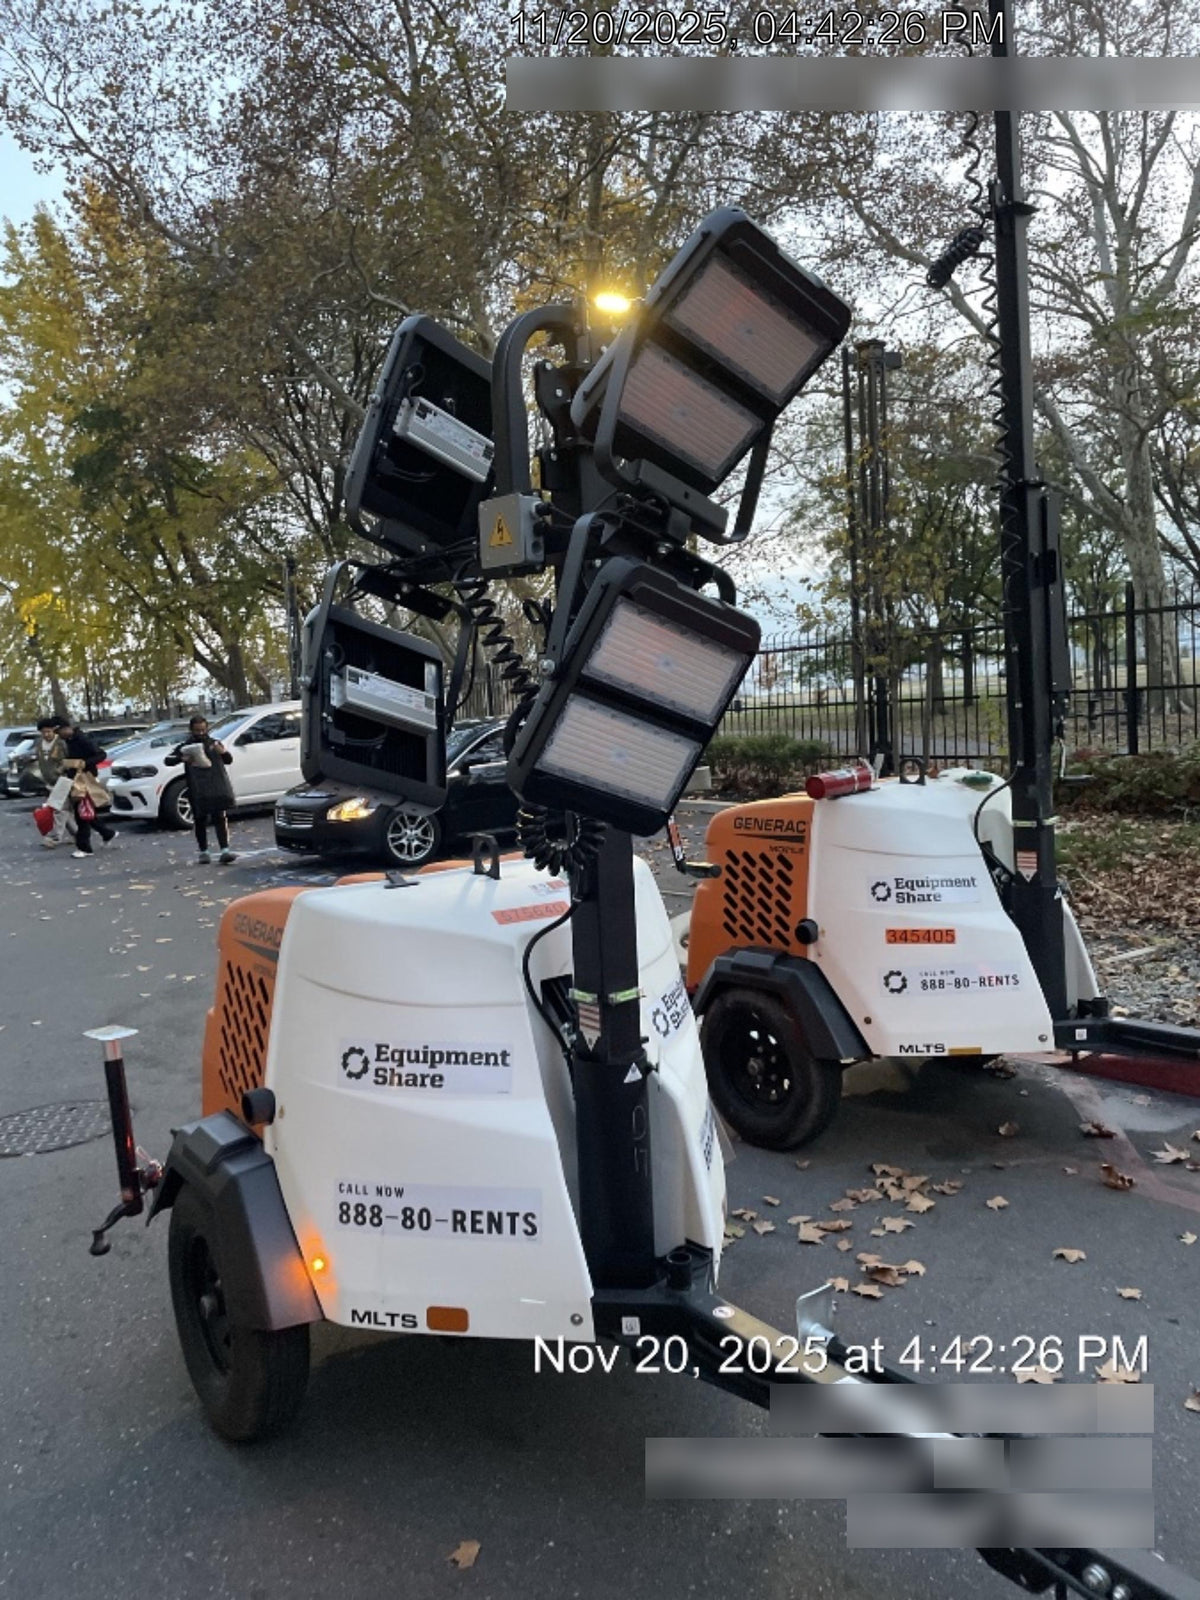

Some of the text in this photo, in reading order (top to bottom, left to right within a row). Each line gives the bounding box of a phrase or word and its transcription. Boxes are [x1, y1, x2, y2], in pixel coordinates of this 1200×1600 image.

[733, 817, 806, 833] GENERAC
[894, 876, 978, 891] Equipment
[895, 892, 942, 904] Share
[886, 929, 956, 944] 345405
[920, 974, 1020, 991] 888-80-RENTS
[374, 1043, 511, 1069] Equipment
[899, 1043, 946, 1054] MLTS
[373, 1067, 445, 1089] Share
[338, 1182, 405, 1199] CALL NOW
[338, 1201, 539, 1237] 888-80-RENTS
[350, 1309, 418, 1330] MLTS
